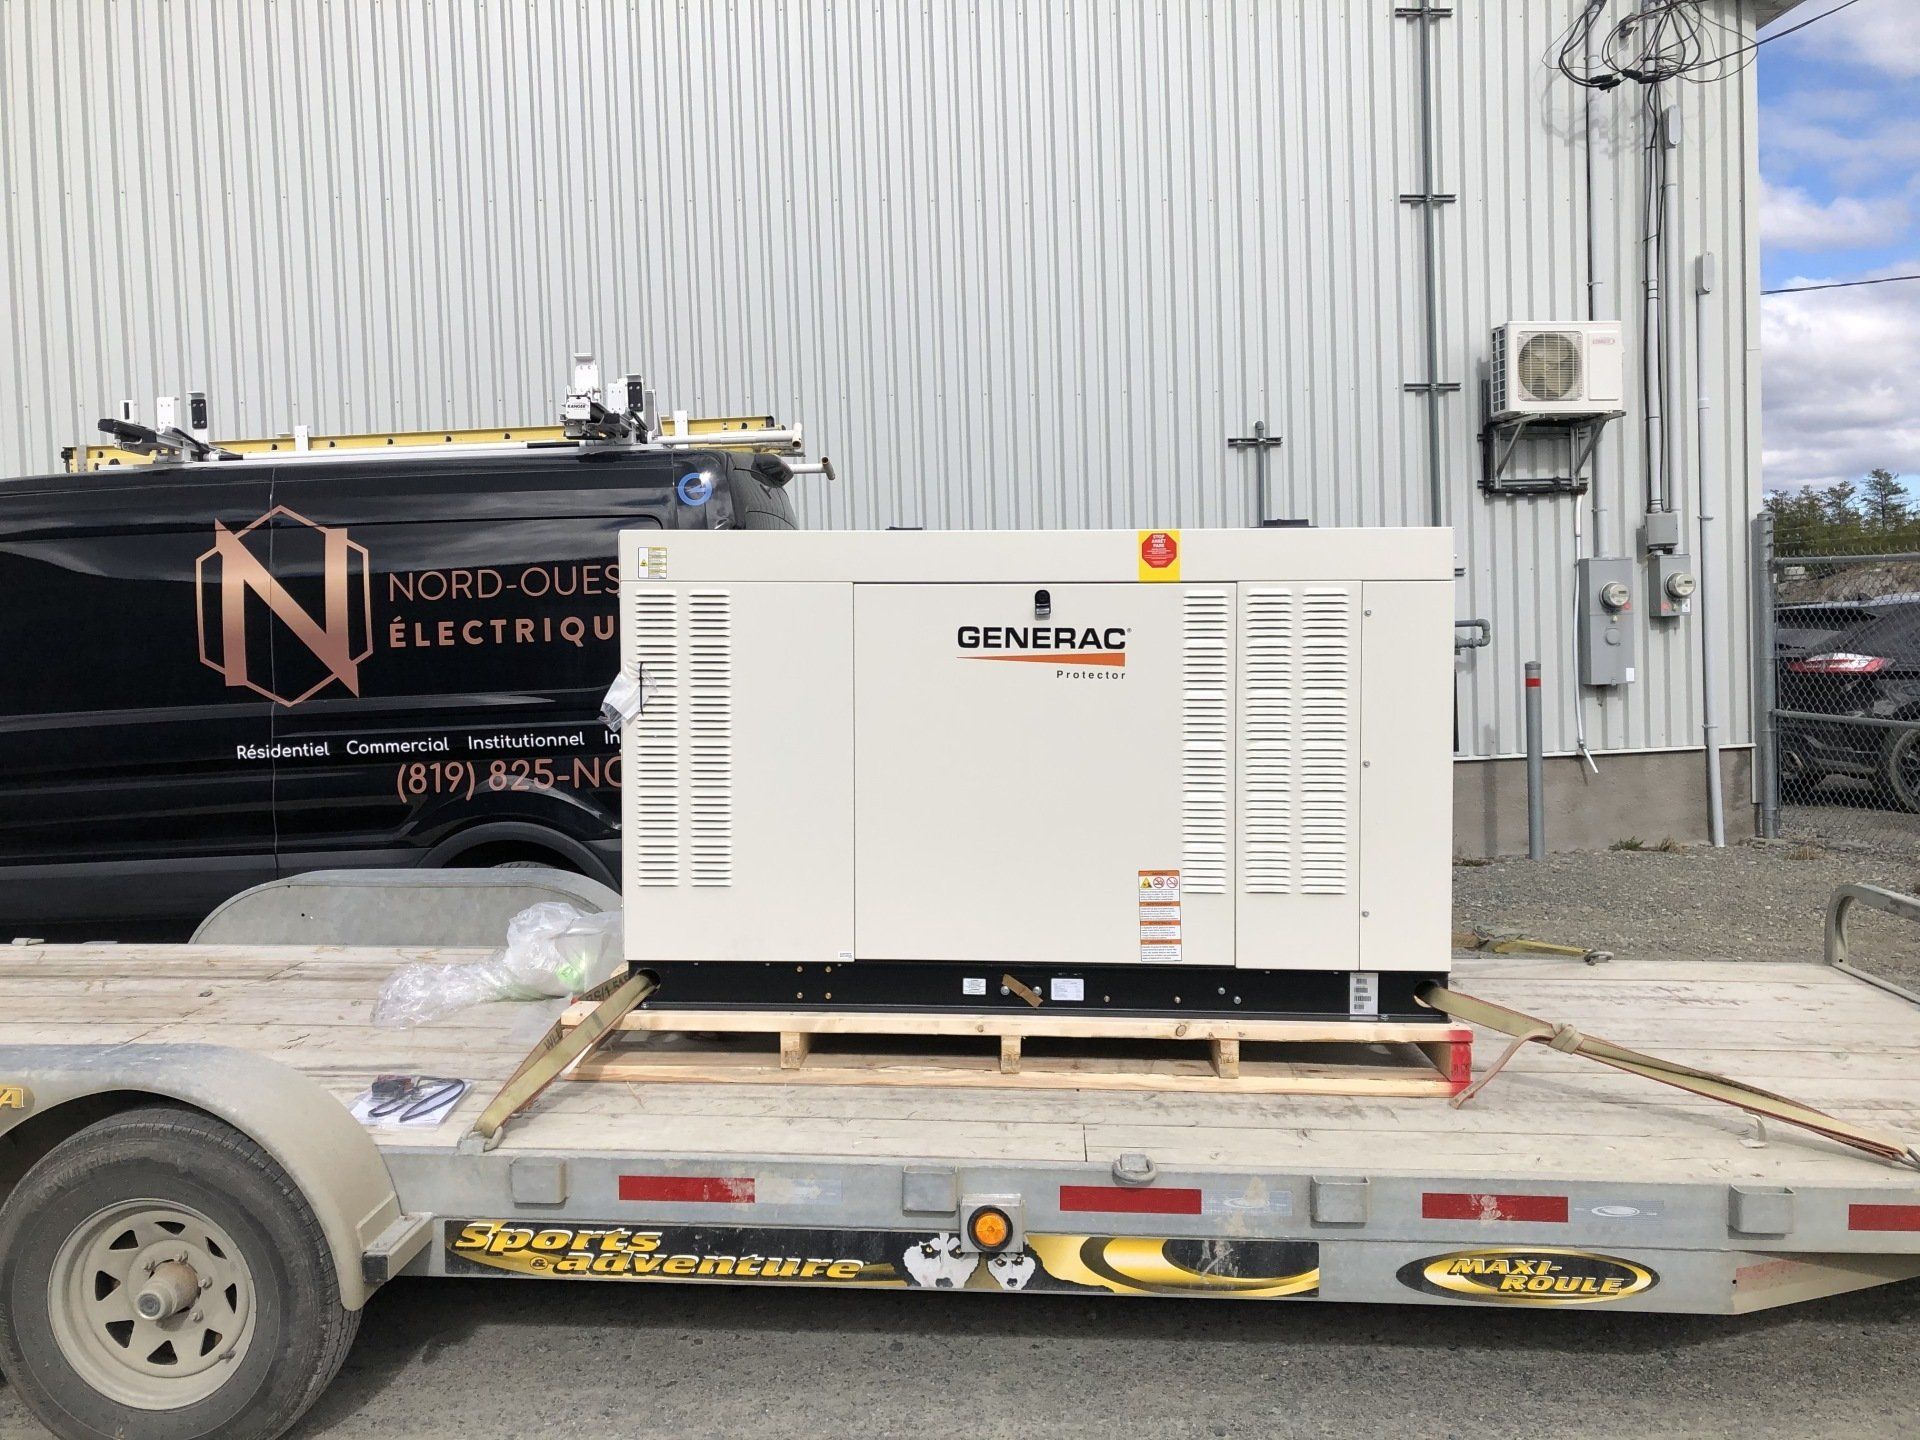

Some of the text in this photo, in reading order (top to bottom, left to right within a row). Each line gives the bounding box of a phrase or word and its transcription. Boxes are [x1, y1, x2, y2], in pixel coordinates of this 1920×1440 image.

[1056, 670, 1126, 680] Protector
[236, 741, 330, 760] Résidentiel
[346, 737, 449, 756] Commercial
[468, 731, 585, 750] Institutionnel
[396, 761, 476, 804] (819)
[455, 1223, 663, 1256] Sports
[552, 1250, 865, 1281] adventure
[1447, 1258, 1563, 1275] MAXI-
[1497, 1275, 1625, 1295] ROULE
